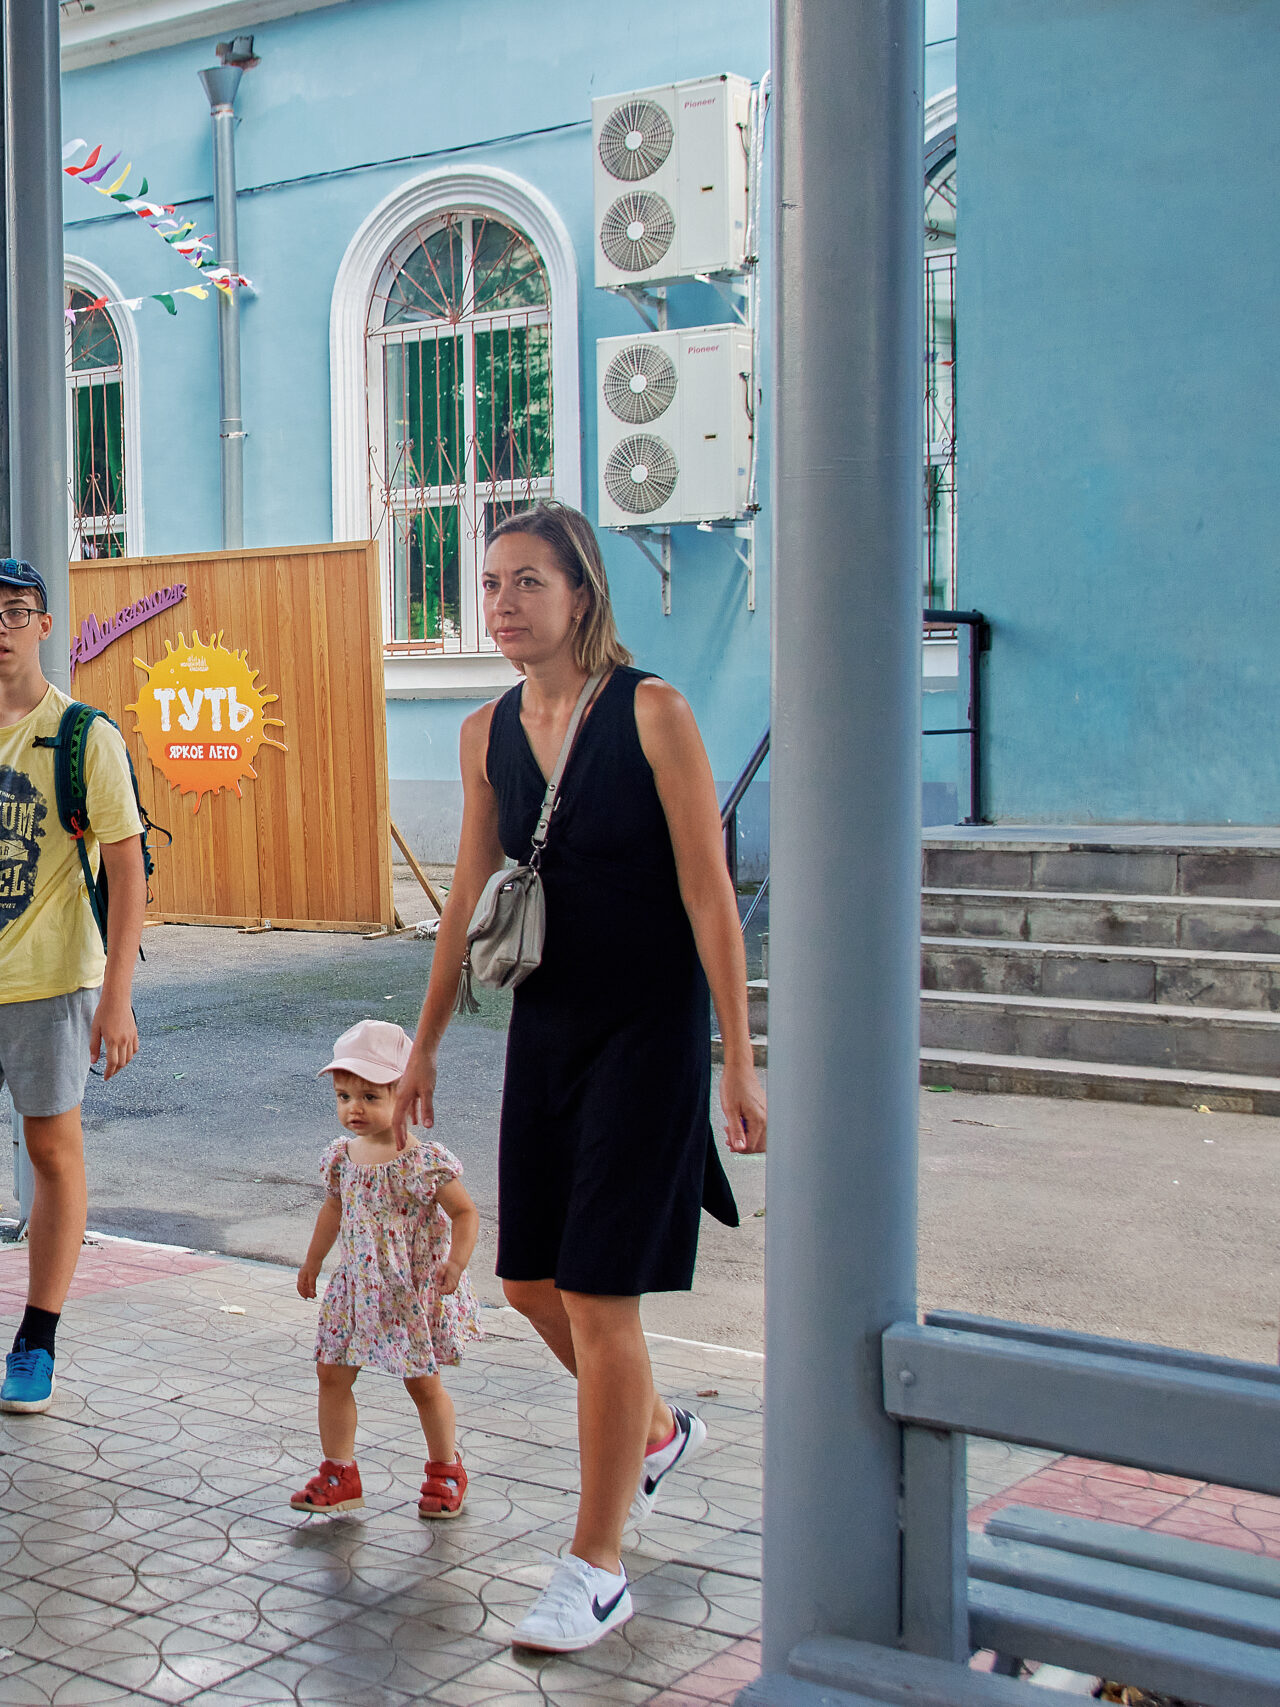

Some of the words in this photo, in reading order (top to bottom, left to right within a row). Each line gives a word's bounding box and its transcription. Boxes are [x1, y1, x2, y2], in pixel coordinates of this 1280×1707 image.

[684, 97, 716, 109] Pioneer
[688, 344, 720, 355] Pioneer
[153, 686, 254, 732] ТУТЬ
[169, 745, 204, 759] ЯРКОЕ
[209, 745, 238, 759] ЛЕТО
